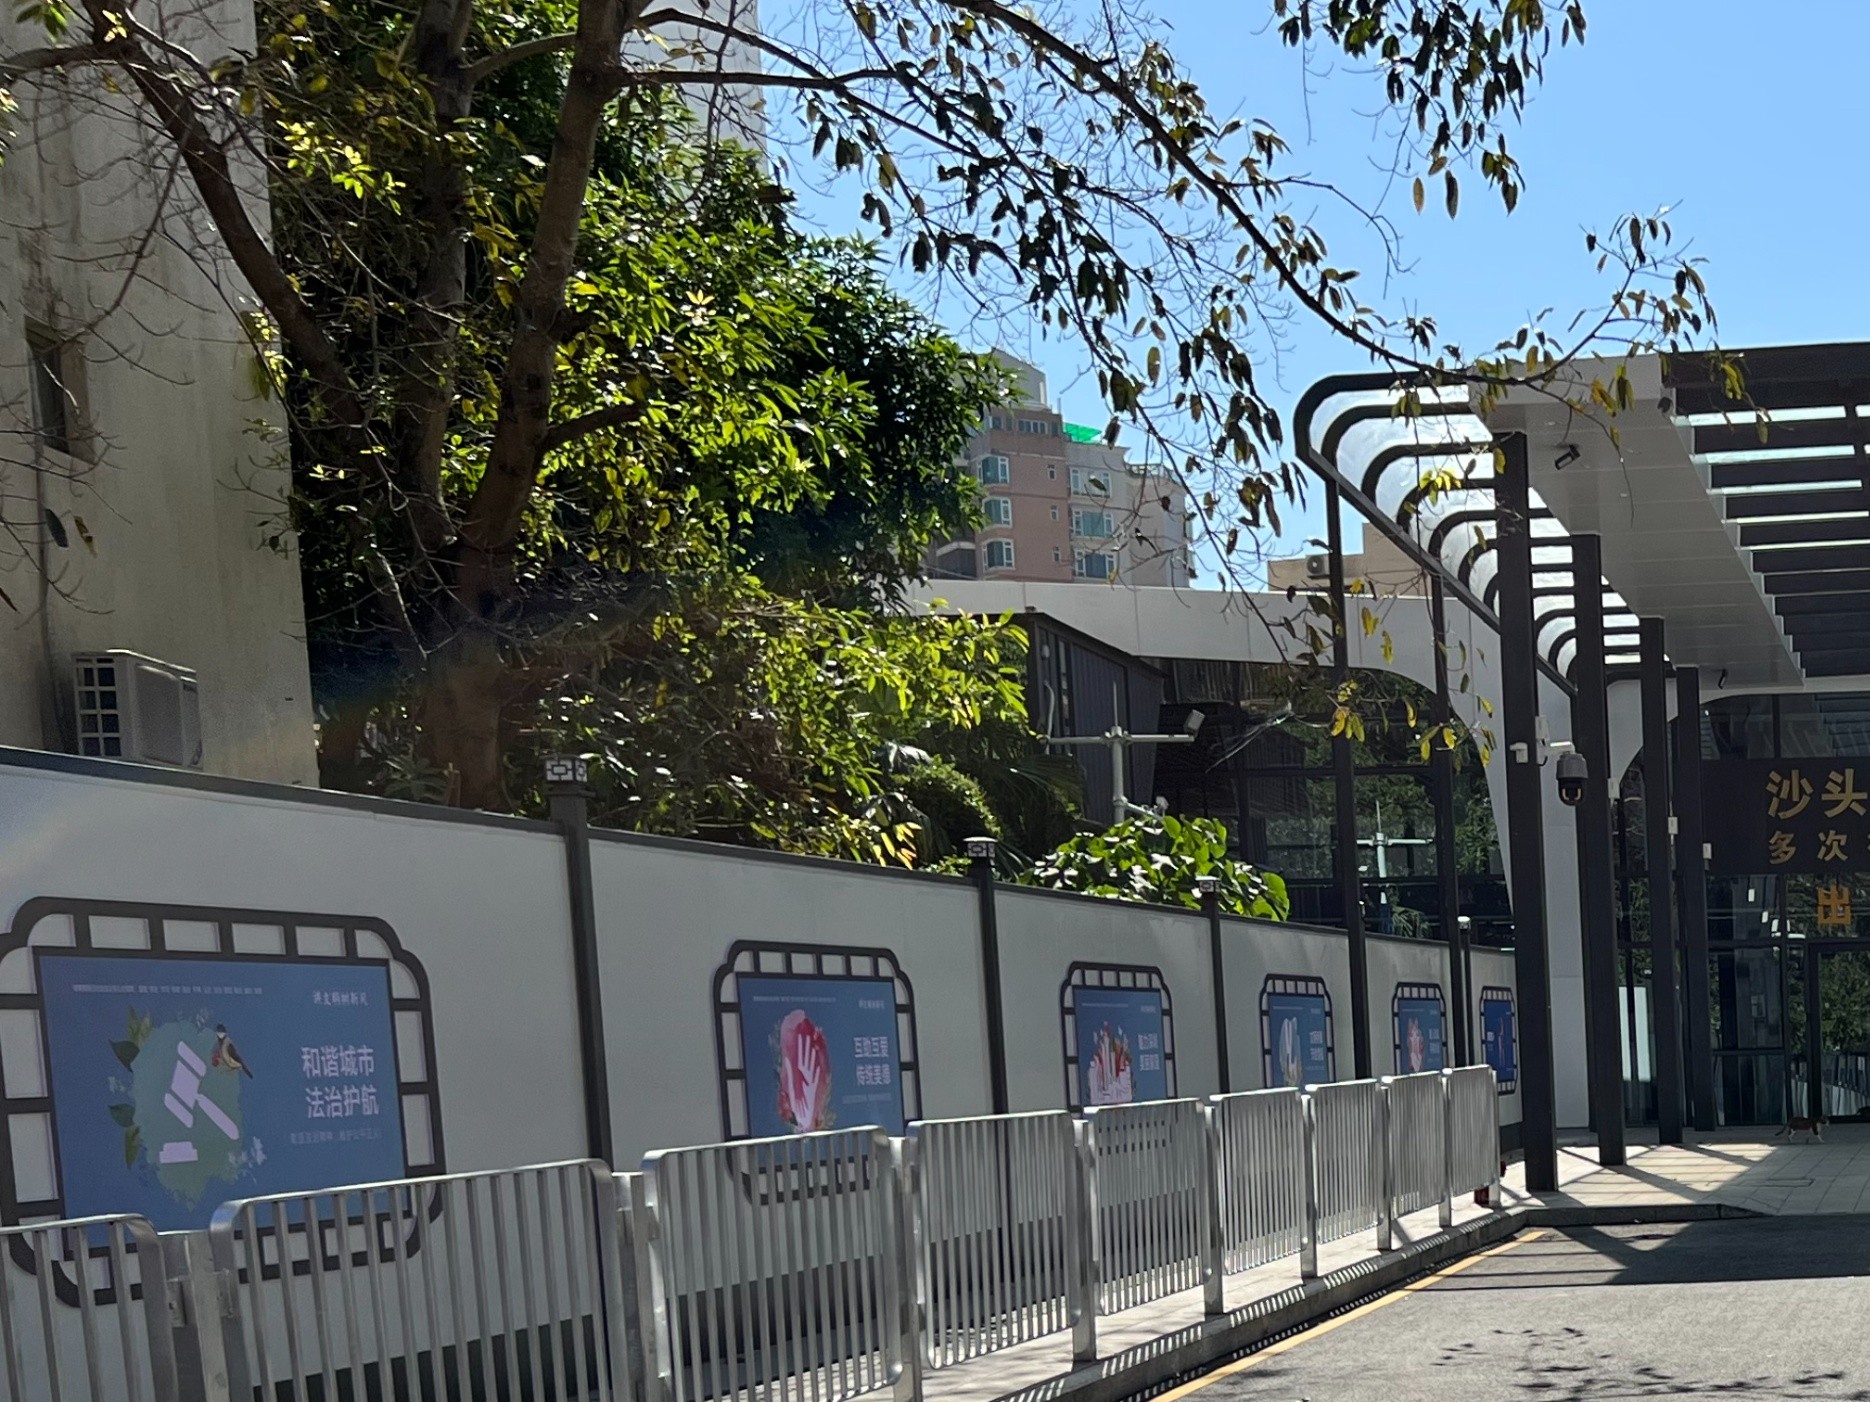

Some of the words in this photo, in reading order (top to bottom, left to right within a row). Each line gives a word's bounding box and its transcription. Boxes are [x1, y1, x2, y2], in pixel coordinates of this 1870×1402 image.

[301, 1045, 375, 1078] 和谐城市
[305, 1084, 380, 1119] 法治护航
